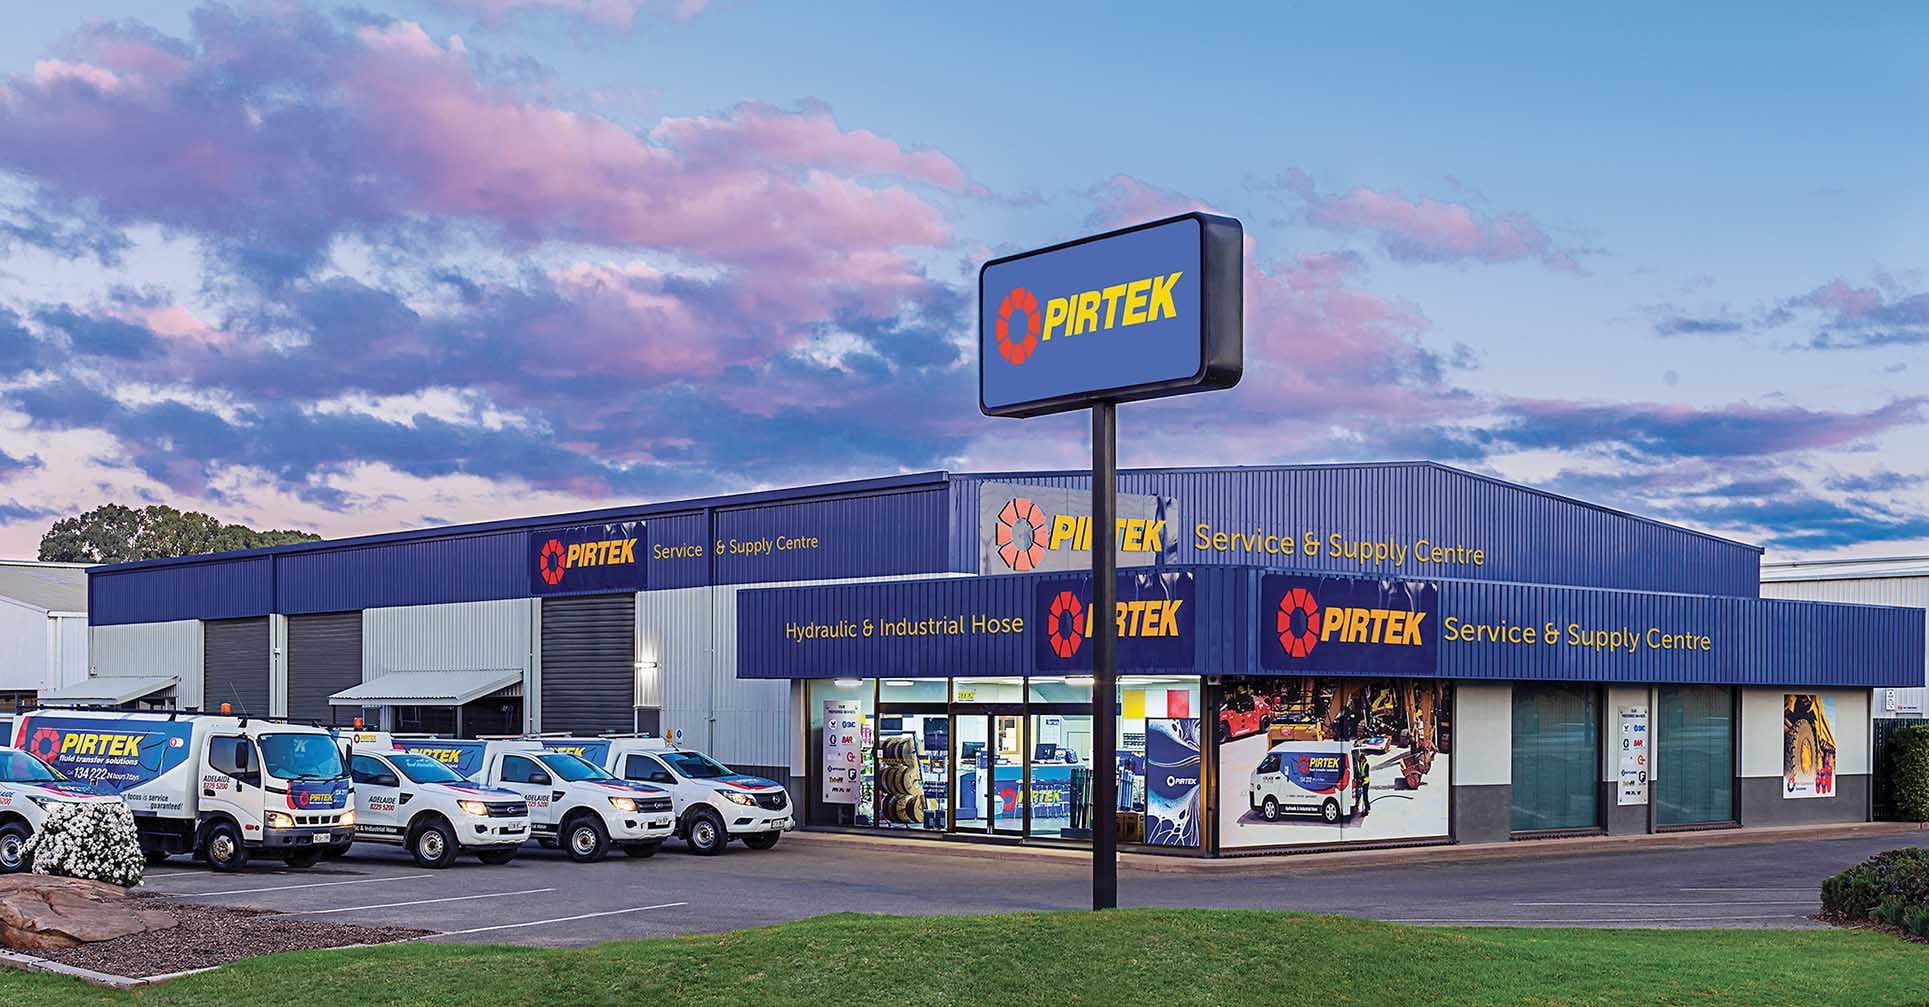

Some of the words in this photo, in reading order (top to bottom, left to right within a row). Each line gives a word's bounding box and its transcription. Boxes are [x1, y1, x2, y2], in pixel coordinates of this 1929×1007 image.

[1042, 271, 1184, 341] PIRTEK
[566, 538, 639, 569] PIRTEK
[653, 544, 703, 560] Service
[716, 540, 726, 555] &
[729, 539, 773, 557] Supply
[776, 536, 819, 551] Centre
[1194, 523, 1295, 555] Service
[1303, 531, 1321, 556] &
[1329, 533, 1408, 566] Supply
[1414, 539, 1485, 566] Centre
[786, 620, 857, 643] Hydraulic
[862, 619, 874, 637] &
[880, 615, 965, 637] Industrial
[972, 614, 1024, 634] Hose
[1085, 600, 1183, 638] RTEK
[1320, 607, 1426, 646] PIRTEK
[1444, 616, 1537, 645] Service
[1544, 622, 1560, 645] &
[1568, 623, 1640, 652] Supply
[1646, 628, 1712, 651] Centre
[60, 733, 144, 757] PIRTEK
[74, 767, 89, 778] 134
[89, 767, 107, 779] 222
[76, 756, 104, 764] transfer
[105, 757, 138, 766] solutions
[1309, 757, 1340, 769] PIRTEK
[203, 775, 230, 783] ADELAIDE
[127, 792, 141, 800] focus
[149, 794, 168, 802] service
[368, 795, 396, 804] ADELAIDE
